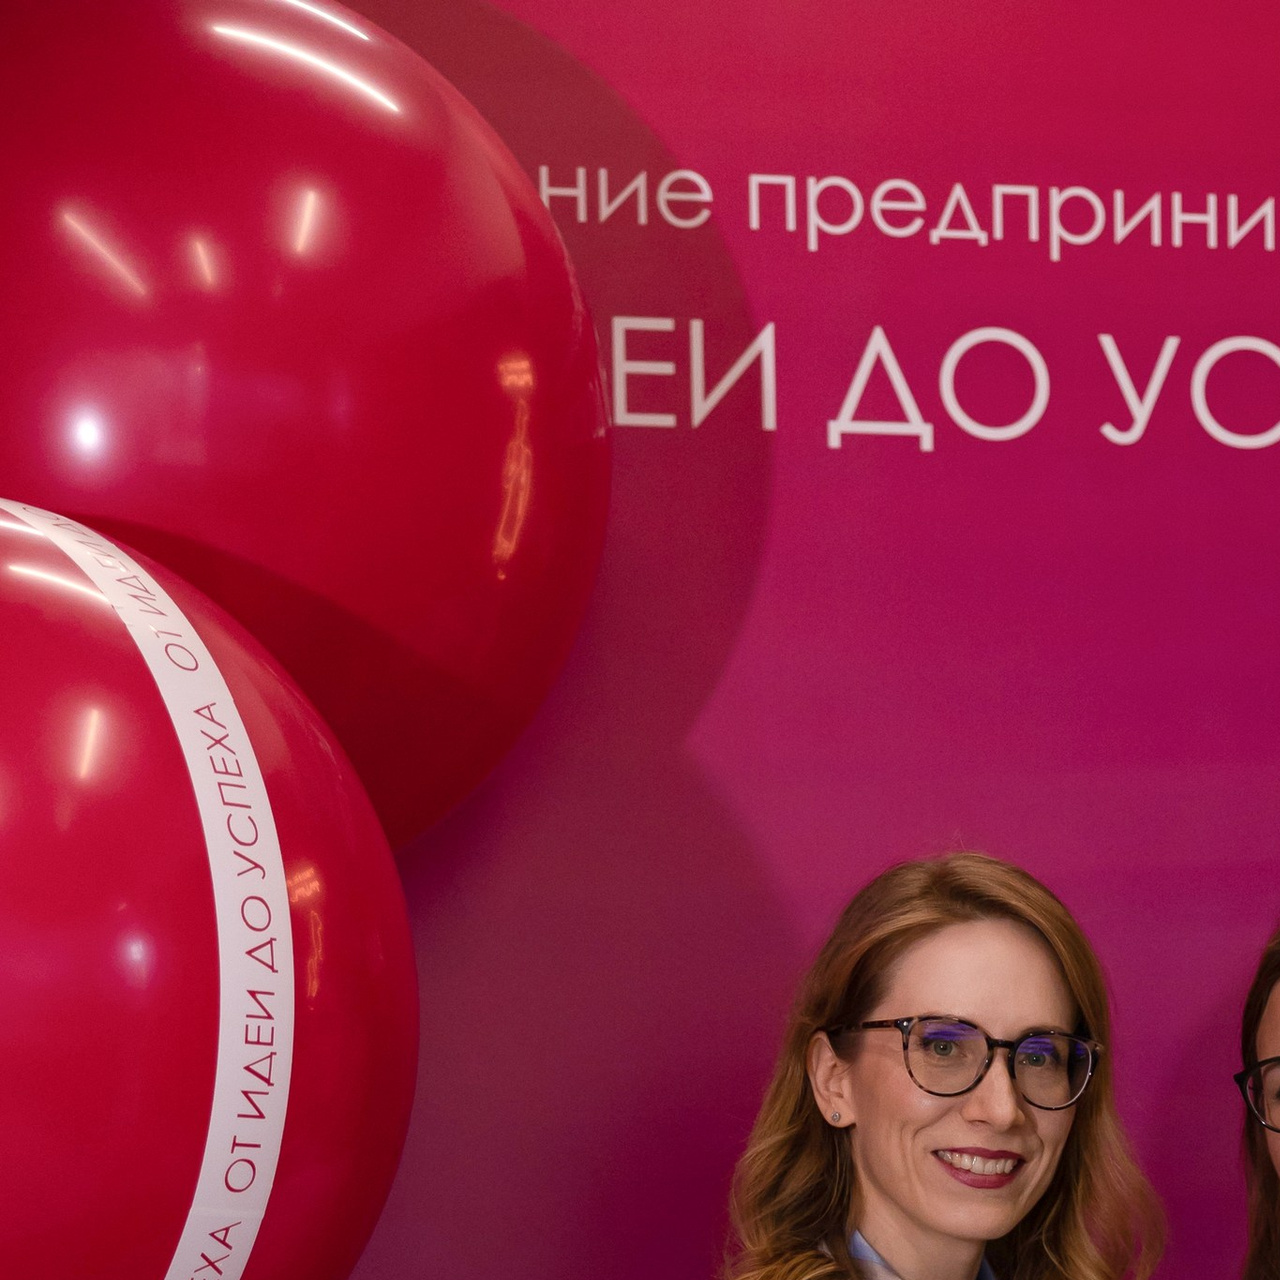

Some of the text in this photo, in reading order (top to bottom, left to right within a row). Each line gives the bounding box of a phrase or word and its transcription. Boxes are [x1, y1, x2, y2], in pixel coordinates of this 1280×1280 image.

[827, 324, 1051, 452] ДО
[192, 702, 266, 880] УСПЕХА
[240, 895, 279, 974] ДО
[237, 988, 278, 1119] ИДЕИ
[224, 1135, 262, 1193] ОТ
